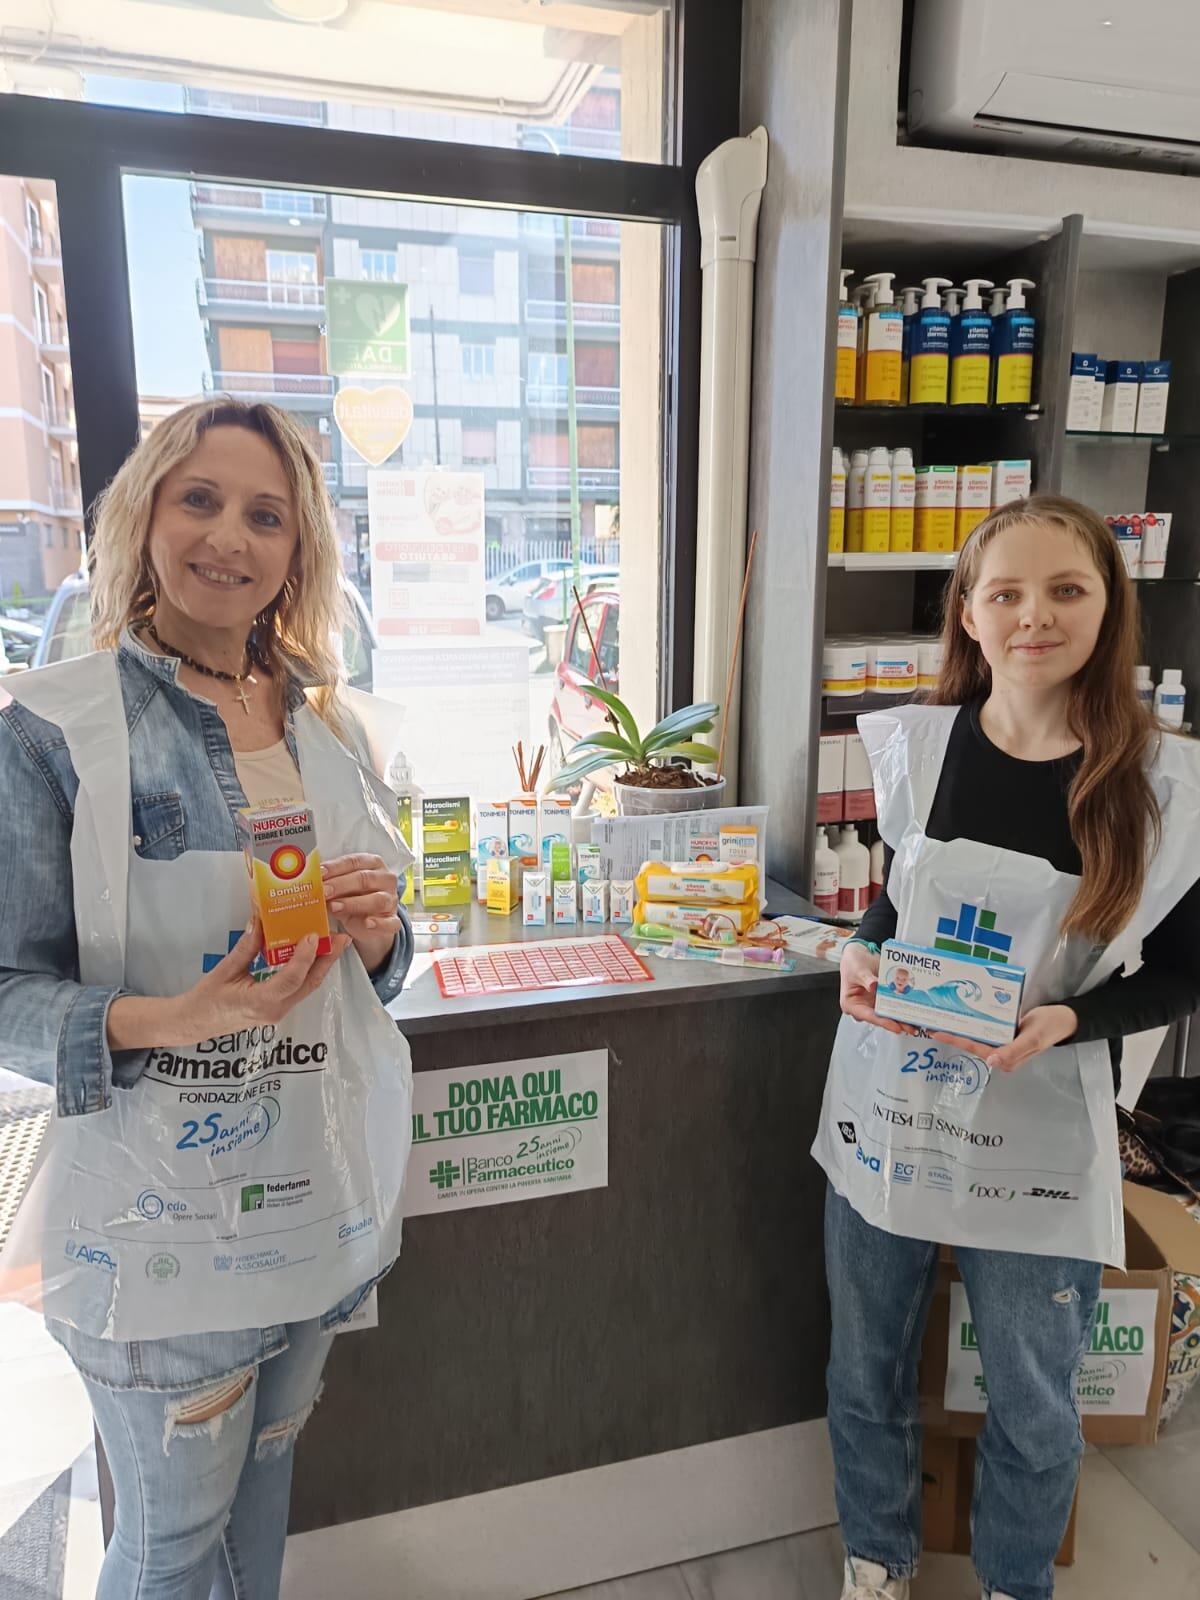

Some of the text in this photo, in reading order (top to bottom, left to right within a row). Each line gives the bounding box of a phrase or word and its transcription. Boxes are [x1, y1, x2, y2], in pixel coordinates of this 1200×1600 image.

[424, 801, 460, 809] Microclismi
[509, 808, 535, 816] TONIMER
[544, 808, 570, 816] TONIMER
[253, 814, 307, 832] NUROFEN
[254, 831, 278, 841] FEBBRE
[284, 825, 312, 835] DOLORE
[425, 856, 461, 864] Microclismi
[269, 882, 313, 897] Bambini
[885, 949, 941, 972] TONIMER
[901, 1047, 963, 1073] 25 anni
[259, 1079, 281, 1094] ETS
[448, 1069, 561, 1108] DONA QUI
[412, 1090, 598, 1140] IL TUO FARMACO
[872, 1102, 913, 1127] INTESA
[176, 1111, 250, 1150] 25 anni
[210, 1121, 260, 1157] insieme
[516, 1135, 562, 1159] 25 anni
[536, 1142, 570, 1161] insieme
[467, 1154, 513, 1171] Banco
[467, 1158, 575, 1184] Farmaceutico
[894, 1162, 914, 1176] EG
[266, 1179, 311, 1192] federfarma
[977, 1185, 1071, 1199] DOC DHL
[167, 1201, 187, 1212] cdo
[173, 1213, 193, 1221] Opere
[76, 1245, 117, 1269] AIFA
